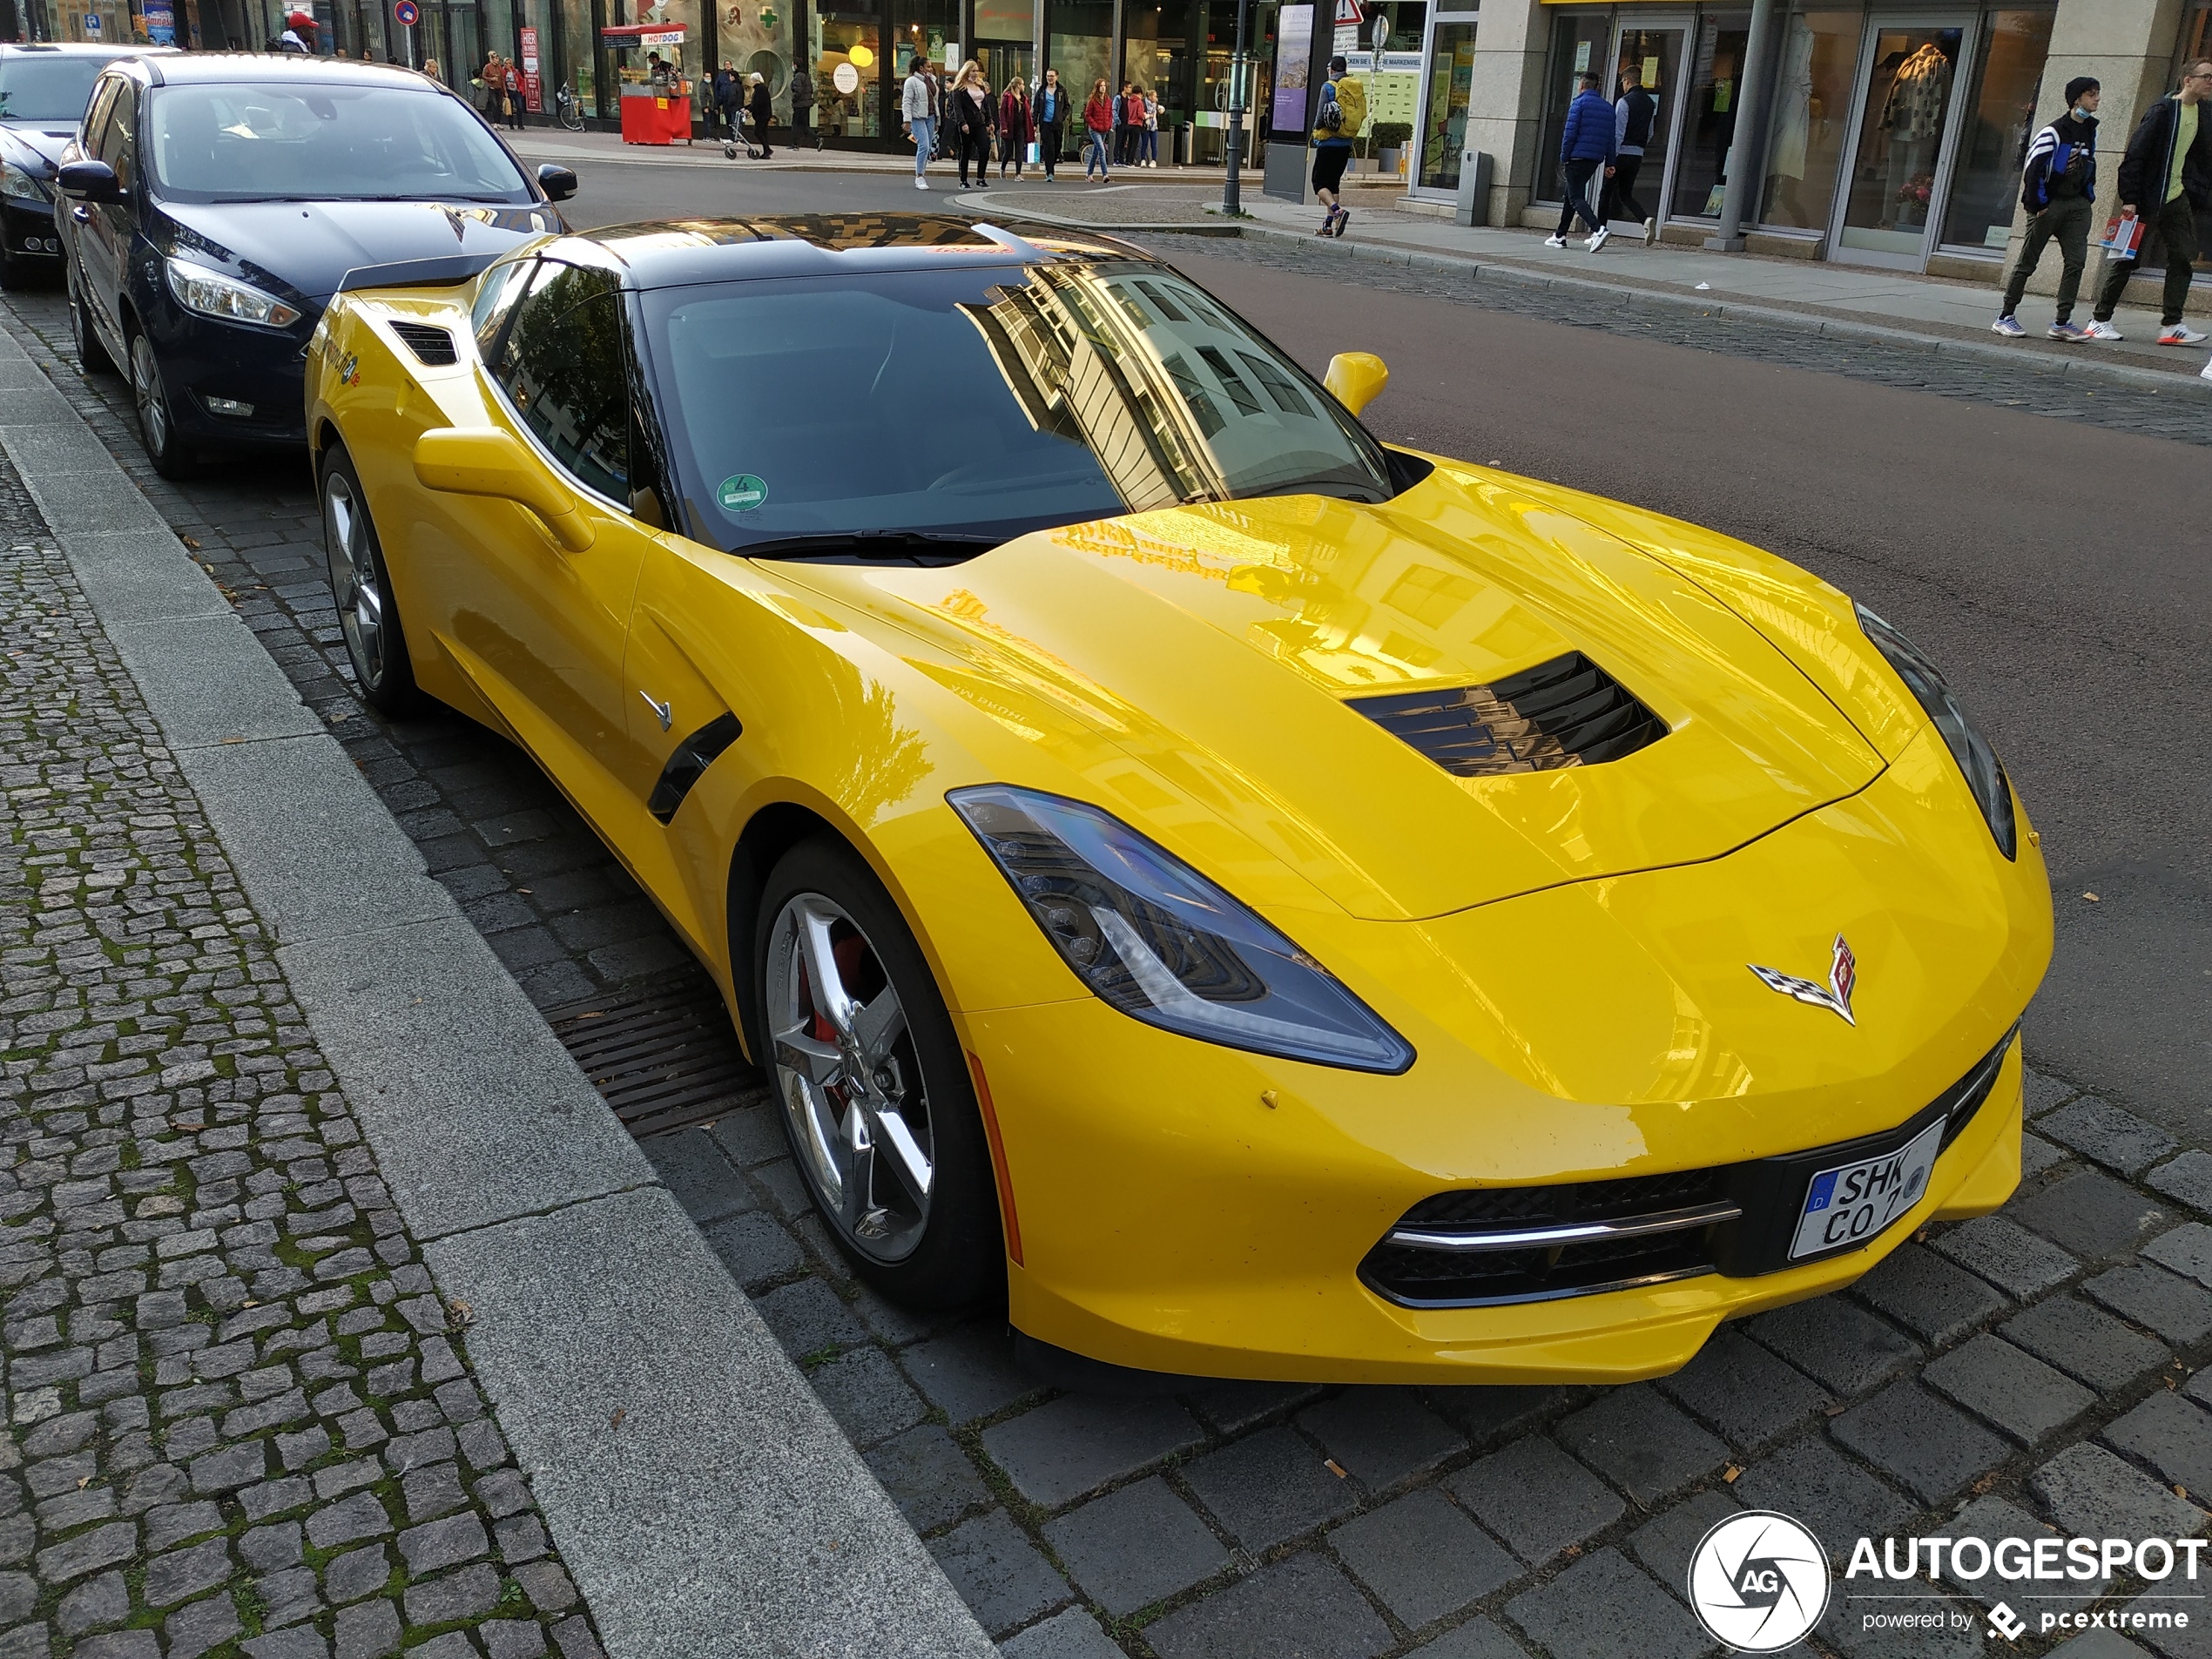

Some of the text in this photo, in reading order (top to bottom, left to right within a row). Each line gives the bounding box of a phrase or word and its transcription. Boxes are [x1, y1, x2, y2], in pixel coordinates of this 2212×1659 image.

[735, 476, 749, 492] 4
[1838, 1148, 1912, 1205] SHK
[1813, 1197, 1824, 1210] D
[1824, 1184, 1903, 1244] CO 7
